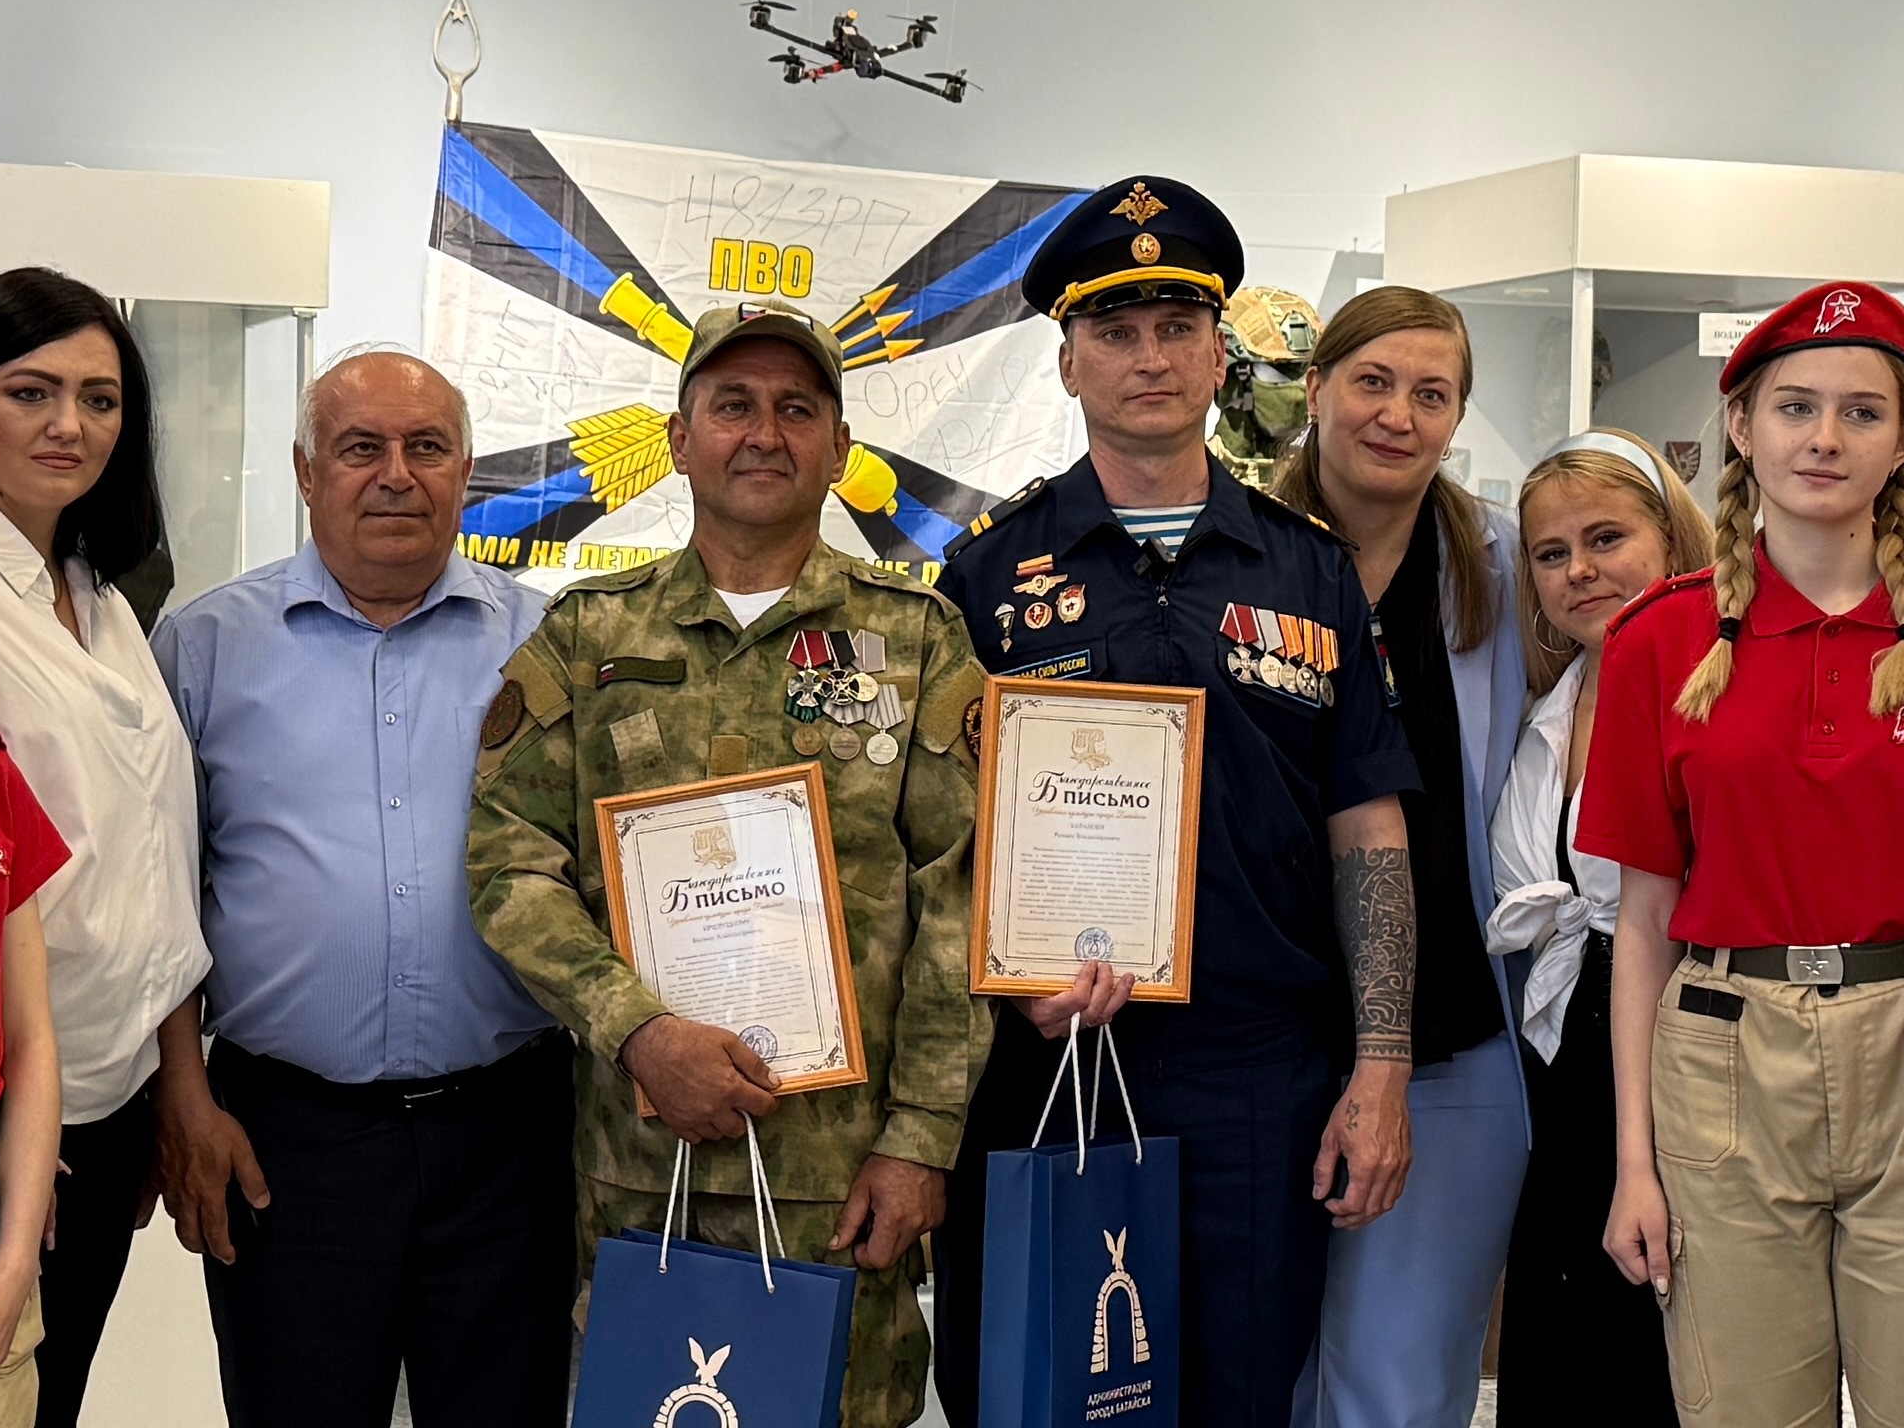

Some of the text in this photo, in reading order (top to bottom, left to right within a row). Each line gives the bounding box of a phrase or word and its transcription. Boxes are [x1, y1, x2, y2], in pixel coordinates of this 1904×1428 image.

[708, 236, 814, 299] ПВО
[527, 539, 568, 569] НЕ
[1086, 1379, 1152, 1407] АДМИНИСТРАЦИЯ
[1085, 1395, 1152, 1422] ГОРОДА БАТАЙСКА
